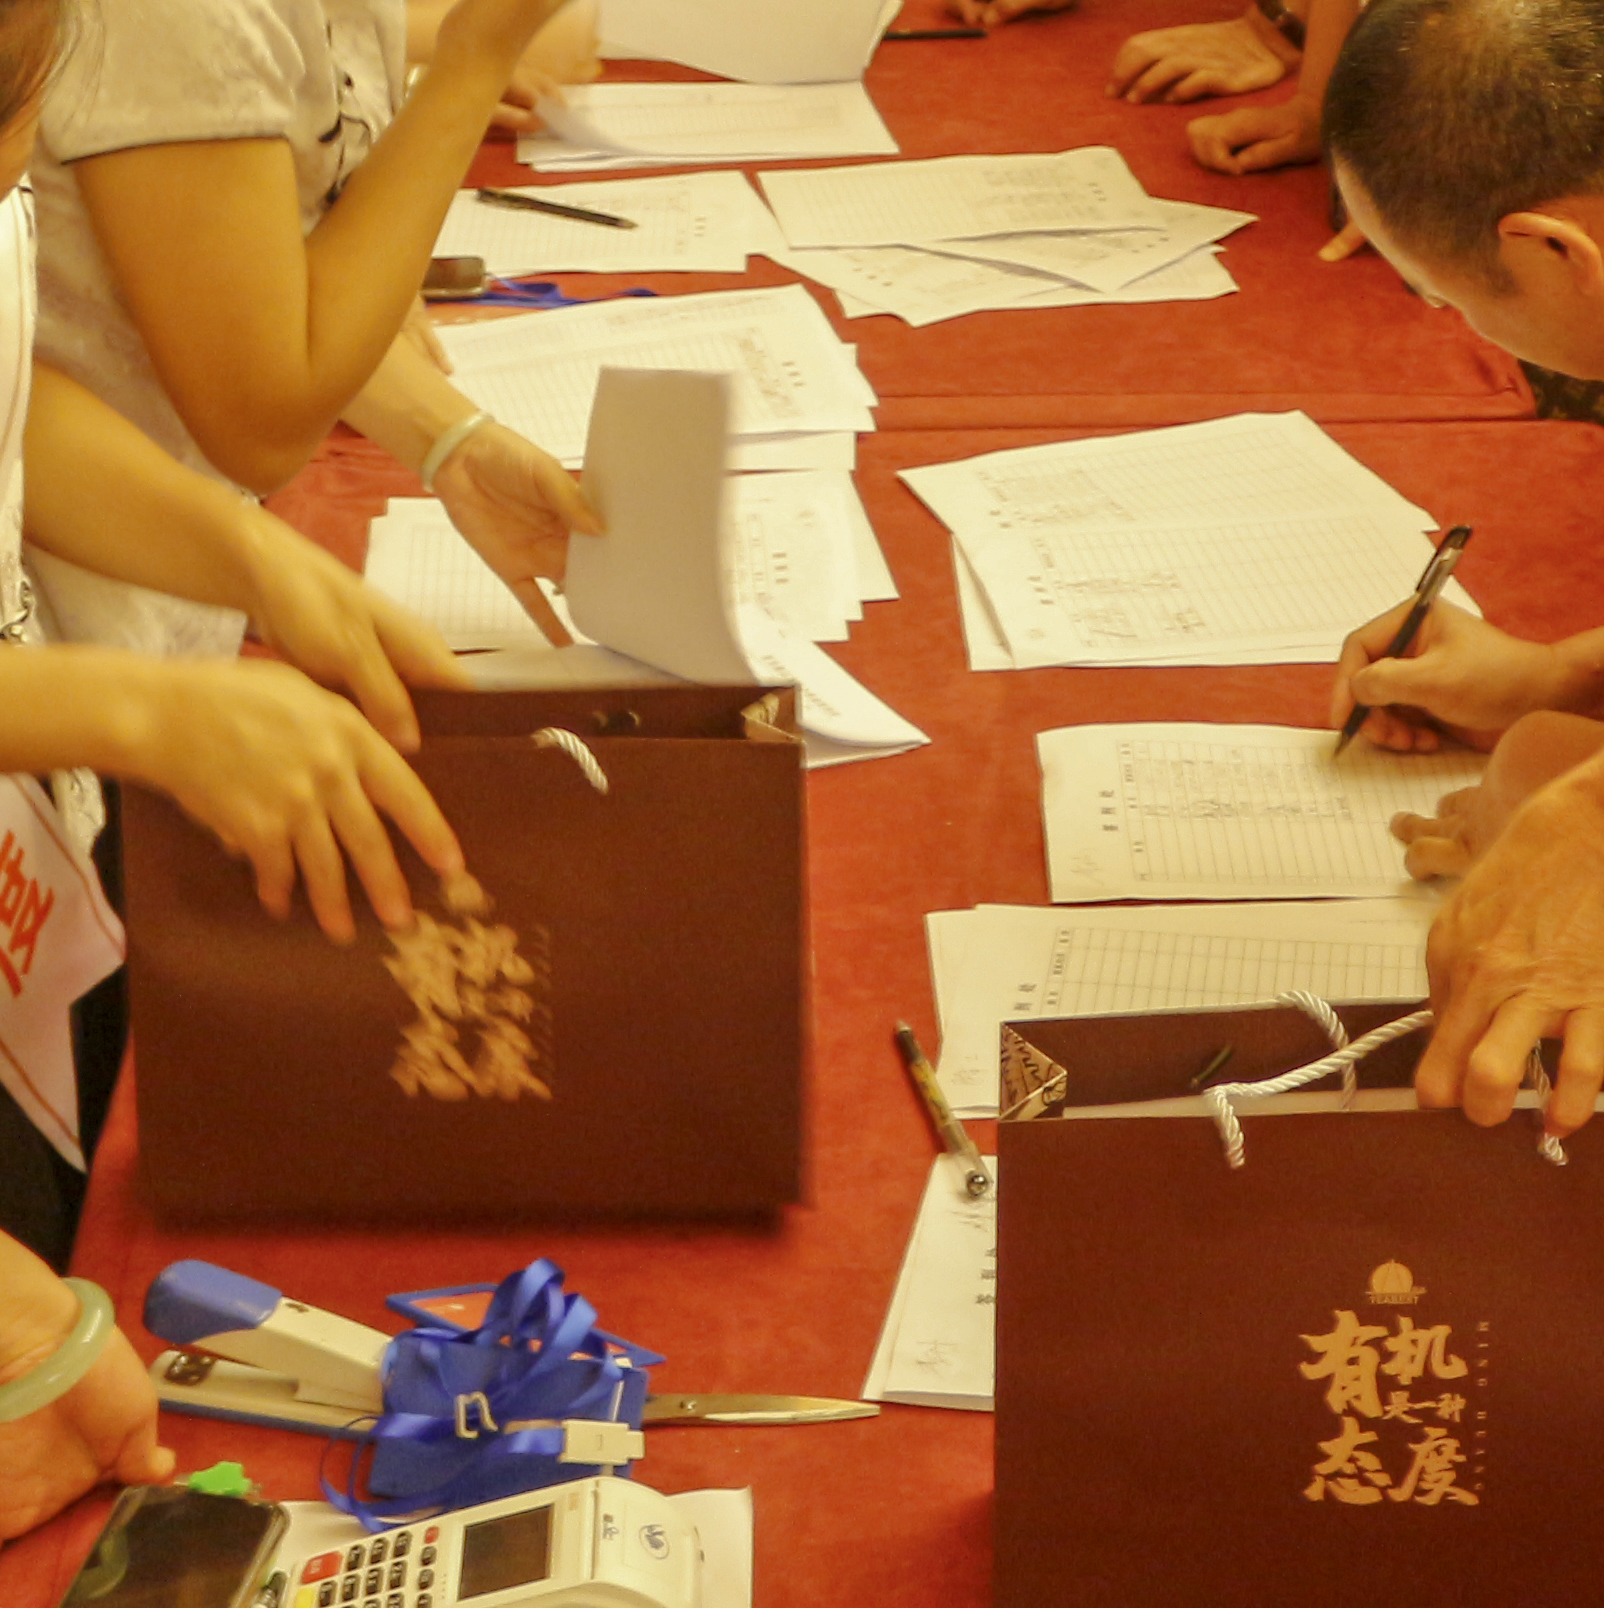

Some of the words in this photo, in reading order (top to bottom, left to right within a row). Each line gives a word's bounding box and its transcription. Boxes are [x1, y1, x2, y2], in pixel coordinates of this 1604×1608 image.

[1299, 1309, 1467, 1418] 有机
[1382, 1391, 1466, 1424] 是一种
[1303, 1418, 1479, 1506] 态度
